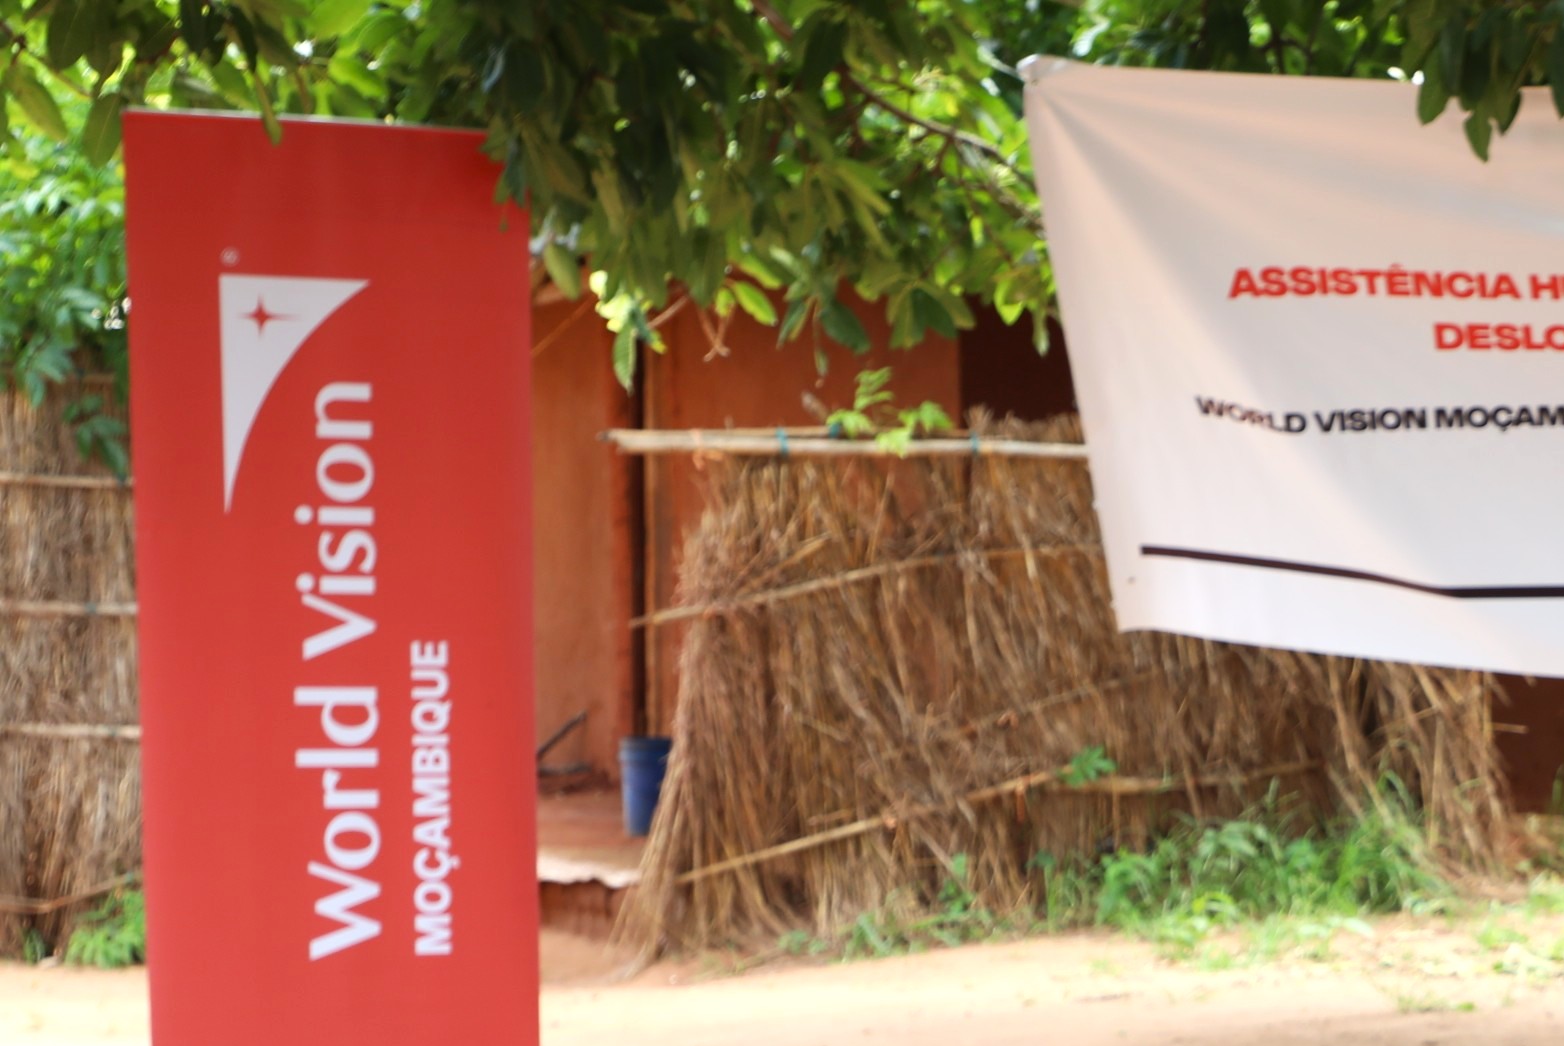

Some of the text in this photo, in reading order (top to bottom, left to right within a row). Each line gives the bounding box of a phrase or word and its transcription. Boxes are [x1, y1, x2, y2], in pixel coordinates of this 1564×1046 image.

[1229, 264, 1520, 300] ASSISTÊNCIA
[1194, 395, 1306, 435] WORLD
[1315, 407, 1427, 433] VISION
[292, 381, 383, 962] World Vision
[410, 639, 461, 956] MOÇAMBIQUE
